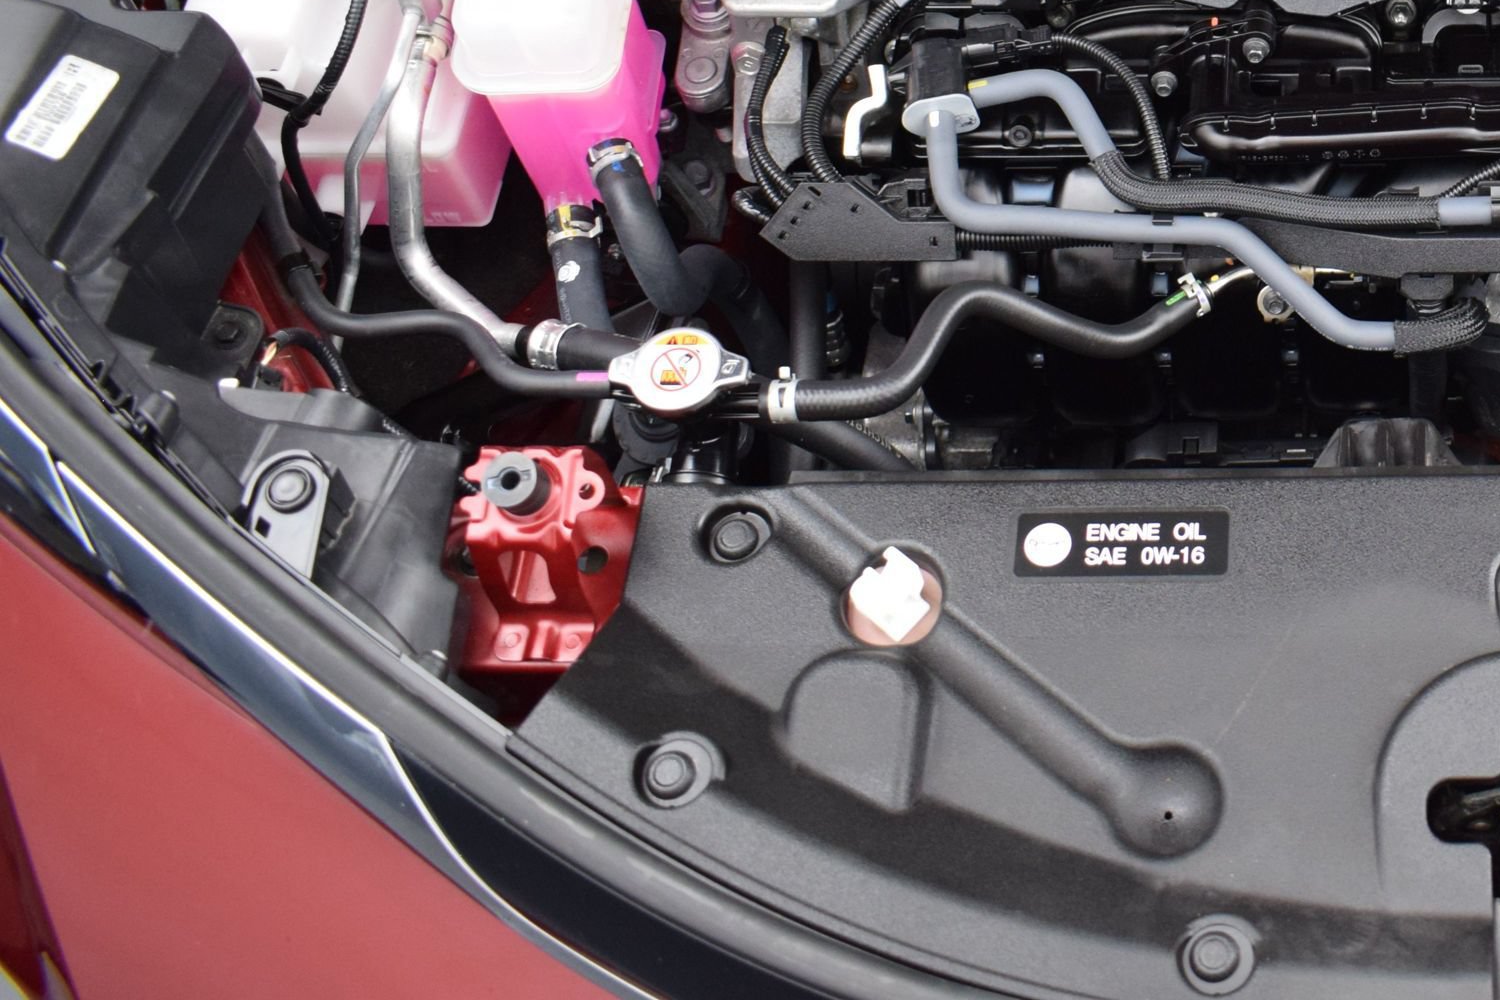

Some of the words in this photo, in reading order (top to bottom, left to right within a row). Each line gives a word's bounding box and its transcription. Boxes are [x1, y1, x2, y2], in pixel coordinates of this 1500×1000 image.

[1085, 522, 1161, 542] ENGINE
[1173, 521, 1207, 541] OIL
[1084, 546, 1128, 566] SAE
[1140, 545, 1206, 565] 0W-16
